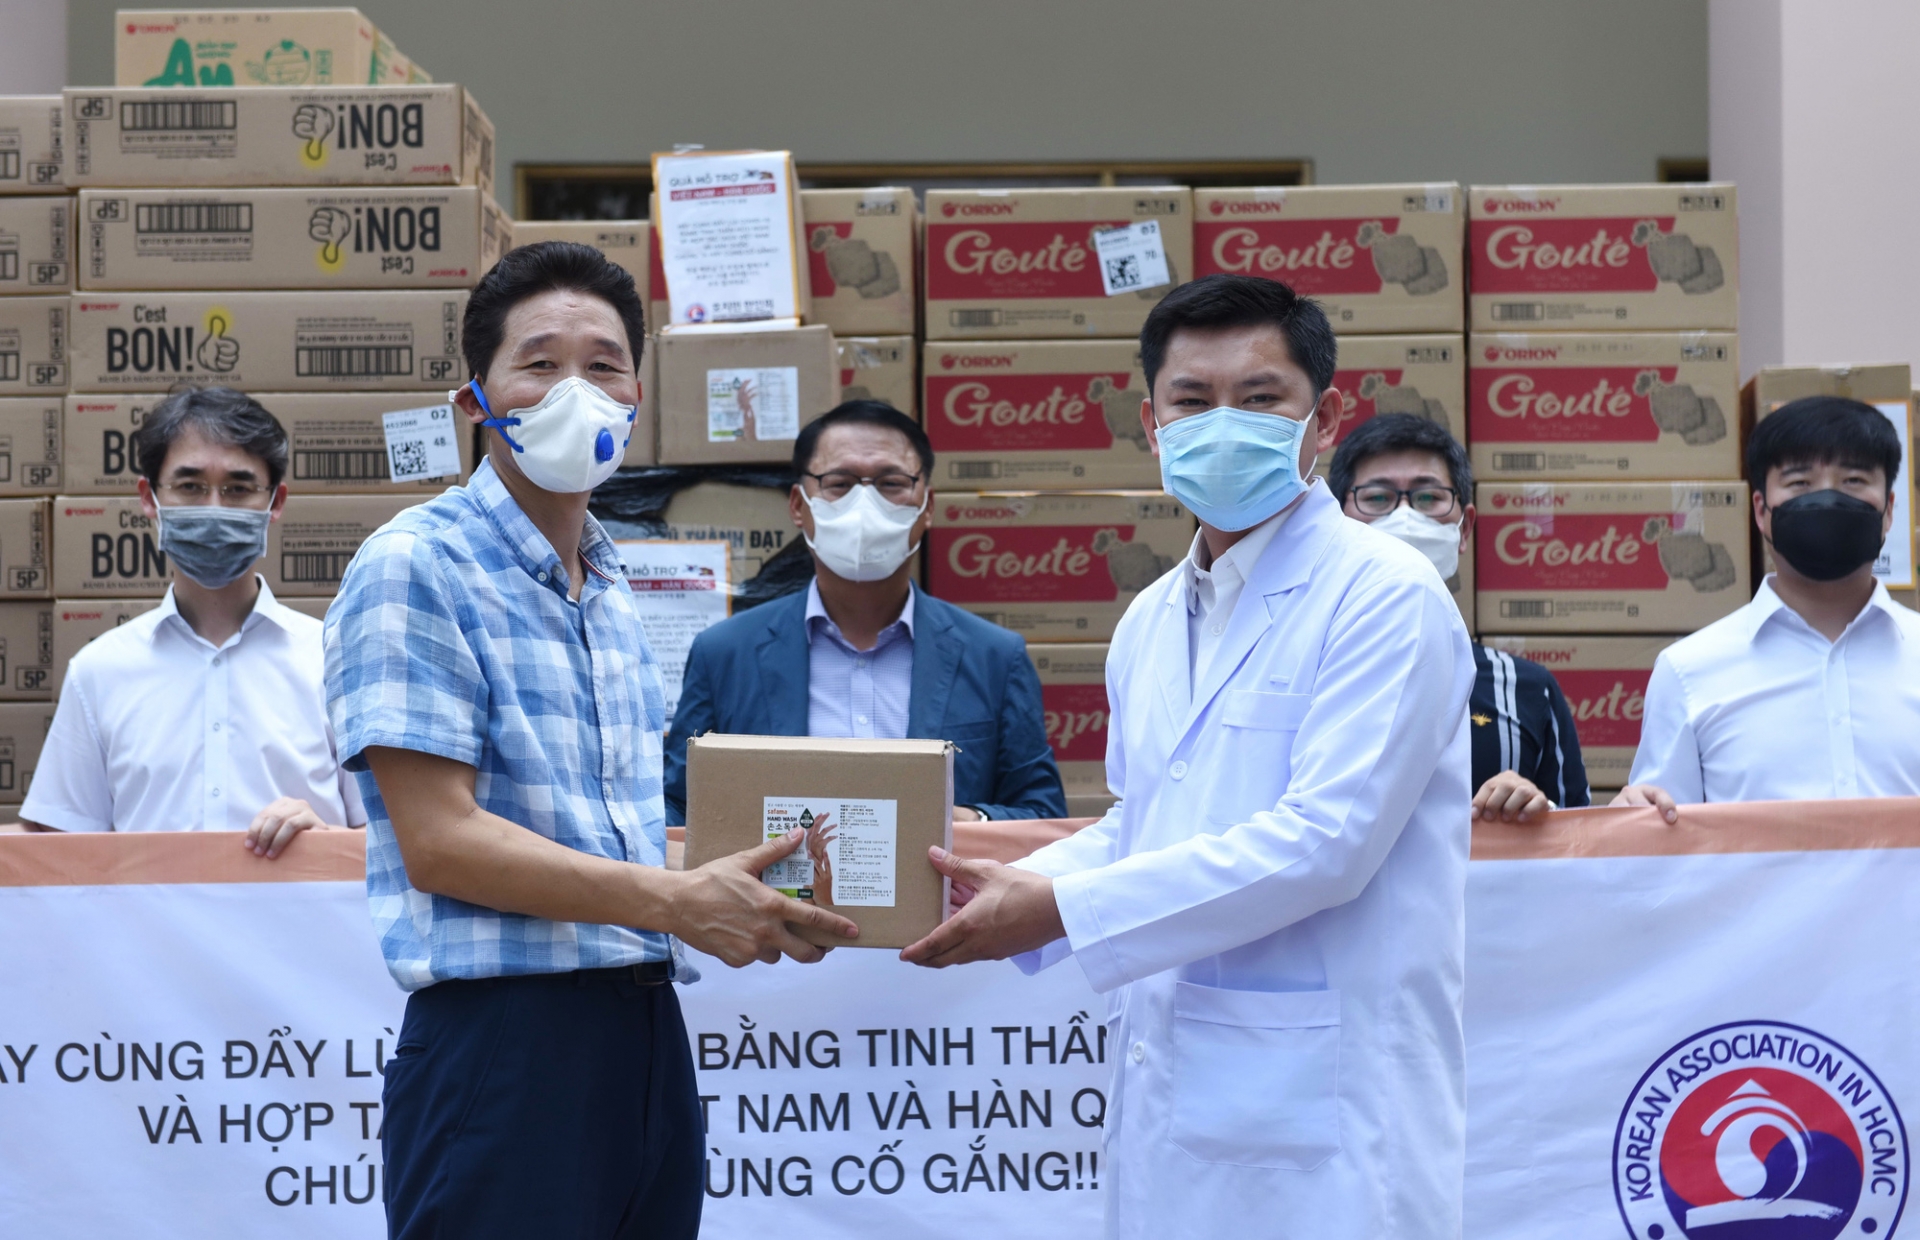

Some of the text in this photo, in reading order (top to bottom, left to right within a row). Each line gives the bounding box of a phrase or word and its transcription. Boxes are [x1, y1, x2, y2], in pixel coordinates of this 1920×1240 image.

[338, 103, 424, 149] BON!
[364, 152, 398, 171] C'est
[36, 165, 59, 183] 5P
[961, 202, 1013, 216] ORION
[1228, 200, 1281, 214] ORION
[1503, 199, 1557, 213] ORION
[354, 207, 441, 252] BON!
[944, 230, 1087, 276] Gouté
[1212, 227, 1355, 272] Gouté
[1486, 225, 1630, 270] Gouté
[37, 265, 60, 283] 5P
[381, 256, 414, 274] C'est
[134, 305, 167, 323] C'est
[107, 327, 194, 372] BON!
[1505, 346, 1558, 360] ORION
[430, 361, 453, 379] 5P
[961, 354, 1013, 368] ORION
[36, 366, 58, 384] 5P
[944, 382, 1086, 428] Gouté
[1488, 373, 1632, 419] Gouté
[431, 408, 448, 420] 02
[30, 467, 53, 485] 5P
[1512, 493, 1565, 508] ORION
[749, 530, 784, 553] ĐẠT
[1494, 520, 1641, 567] Gouté
[949, 532, 1091, 578] Gouté
[16, 569, 39, 588] 5P
[653, 565, 678, 577] TRỢ
[24, 669, 47, 689] 5P
[698, 1014, 841, 1071] BẰNG
[857, 1027, 974, 1067] TINH
[55, 1032, 205, 1082] CÙNG
[221, 1026, 327, 1079] ĐẨY
[738, 1092, 850, 1134] NAM
[867, 1080, 931, 1130] VÀ
[948, 1078, 1052, 1130] HÀN
[138, 1094, 202, 1144] VÀ
[219, 1102, 334, 1152] HỢP
[1625, 1033, 1898, 1203] KOREAN ASSOCIATION IN HCMC
[831, 1139, 905, 1196] CỐ
[923, 1134, 1099, 1194] GẮNG!!
